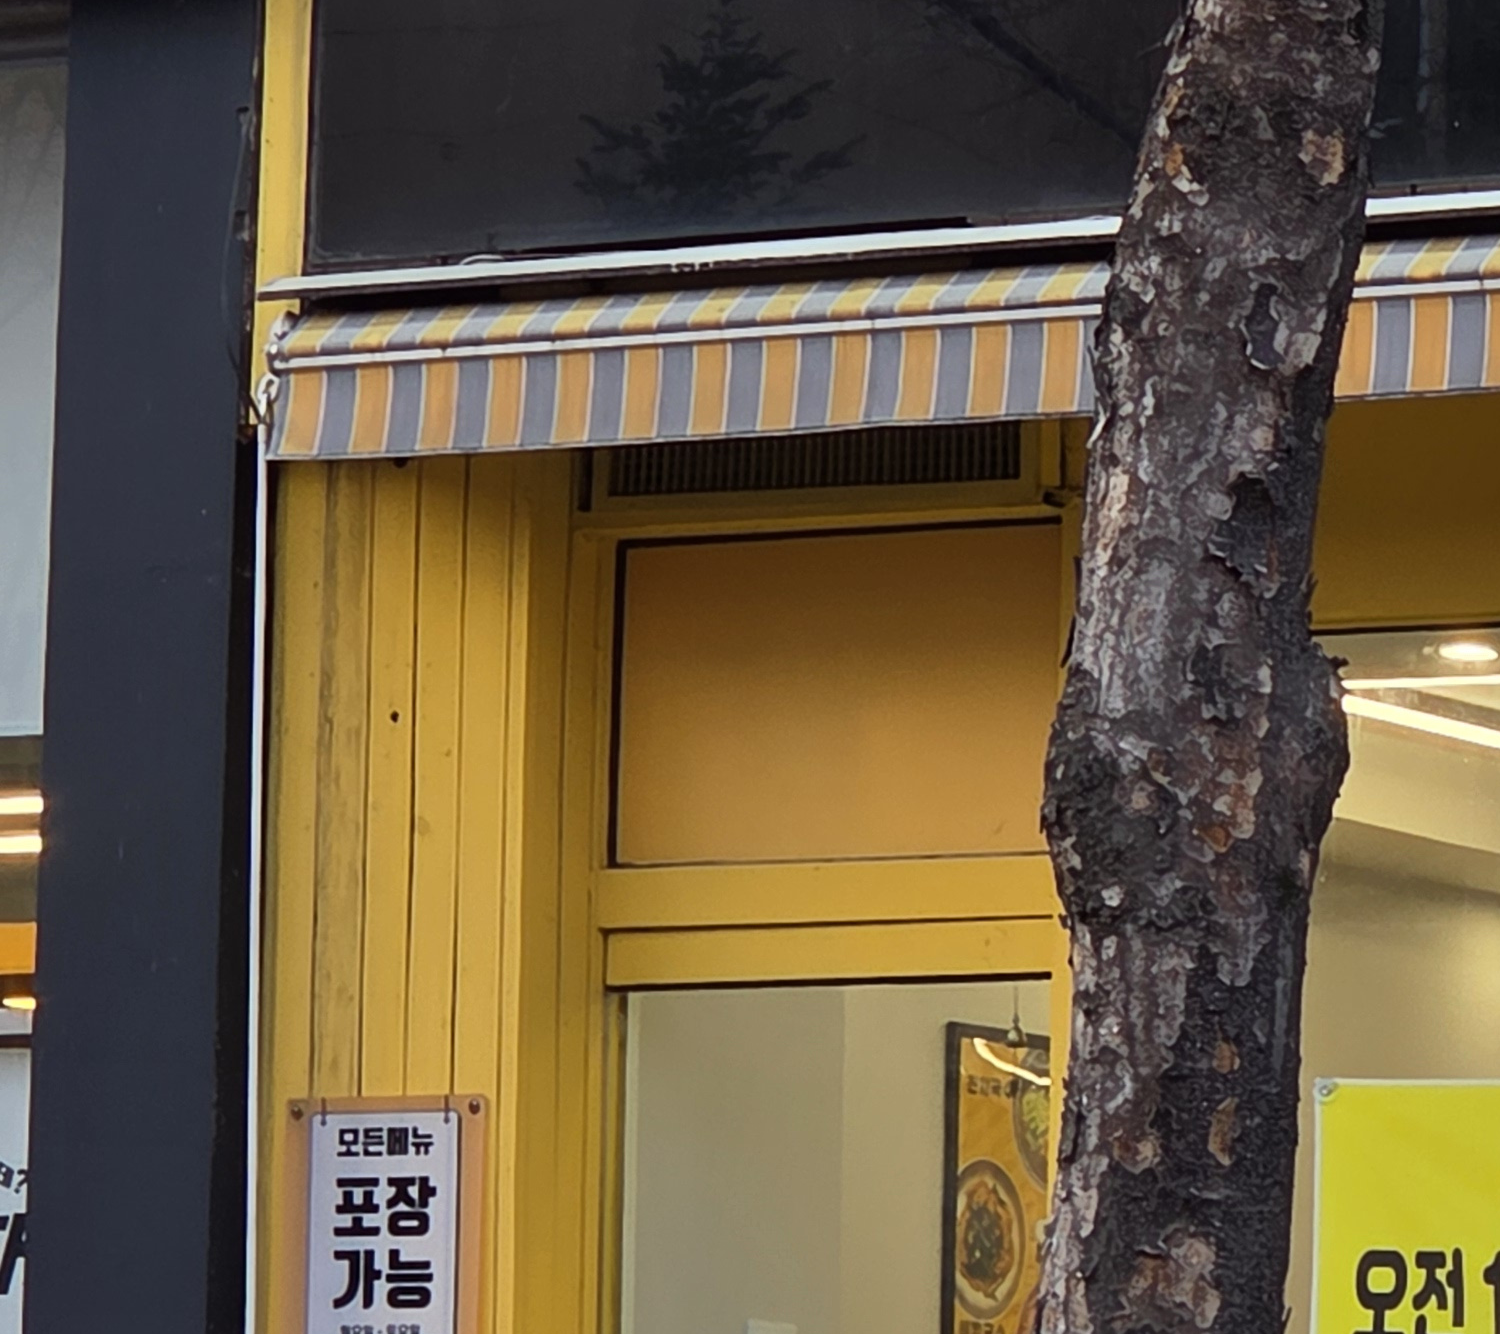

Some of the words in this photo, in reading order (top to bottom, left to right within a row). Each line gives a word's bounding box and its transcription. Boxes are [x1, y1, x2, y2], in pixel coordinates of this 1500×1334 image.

[336, 1126, 434, 1157] 모든메뉴
[333, 1176, 437, 1238] 포장
[332, 1248, 434, 1310] 가능
